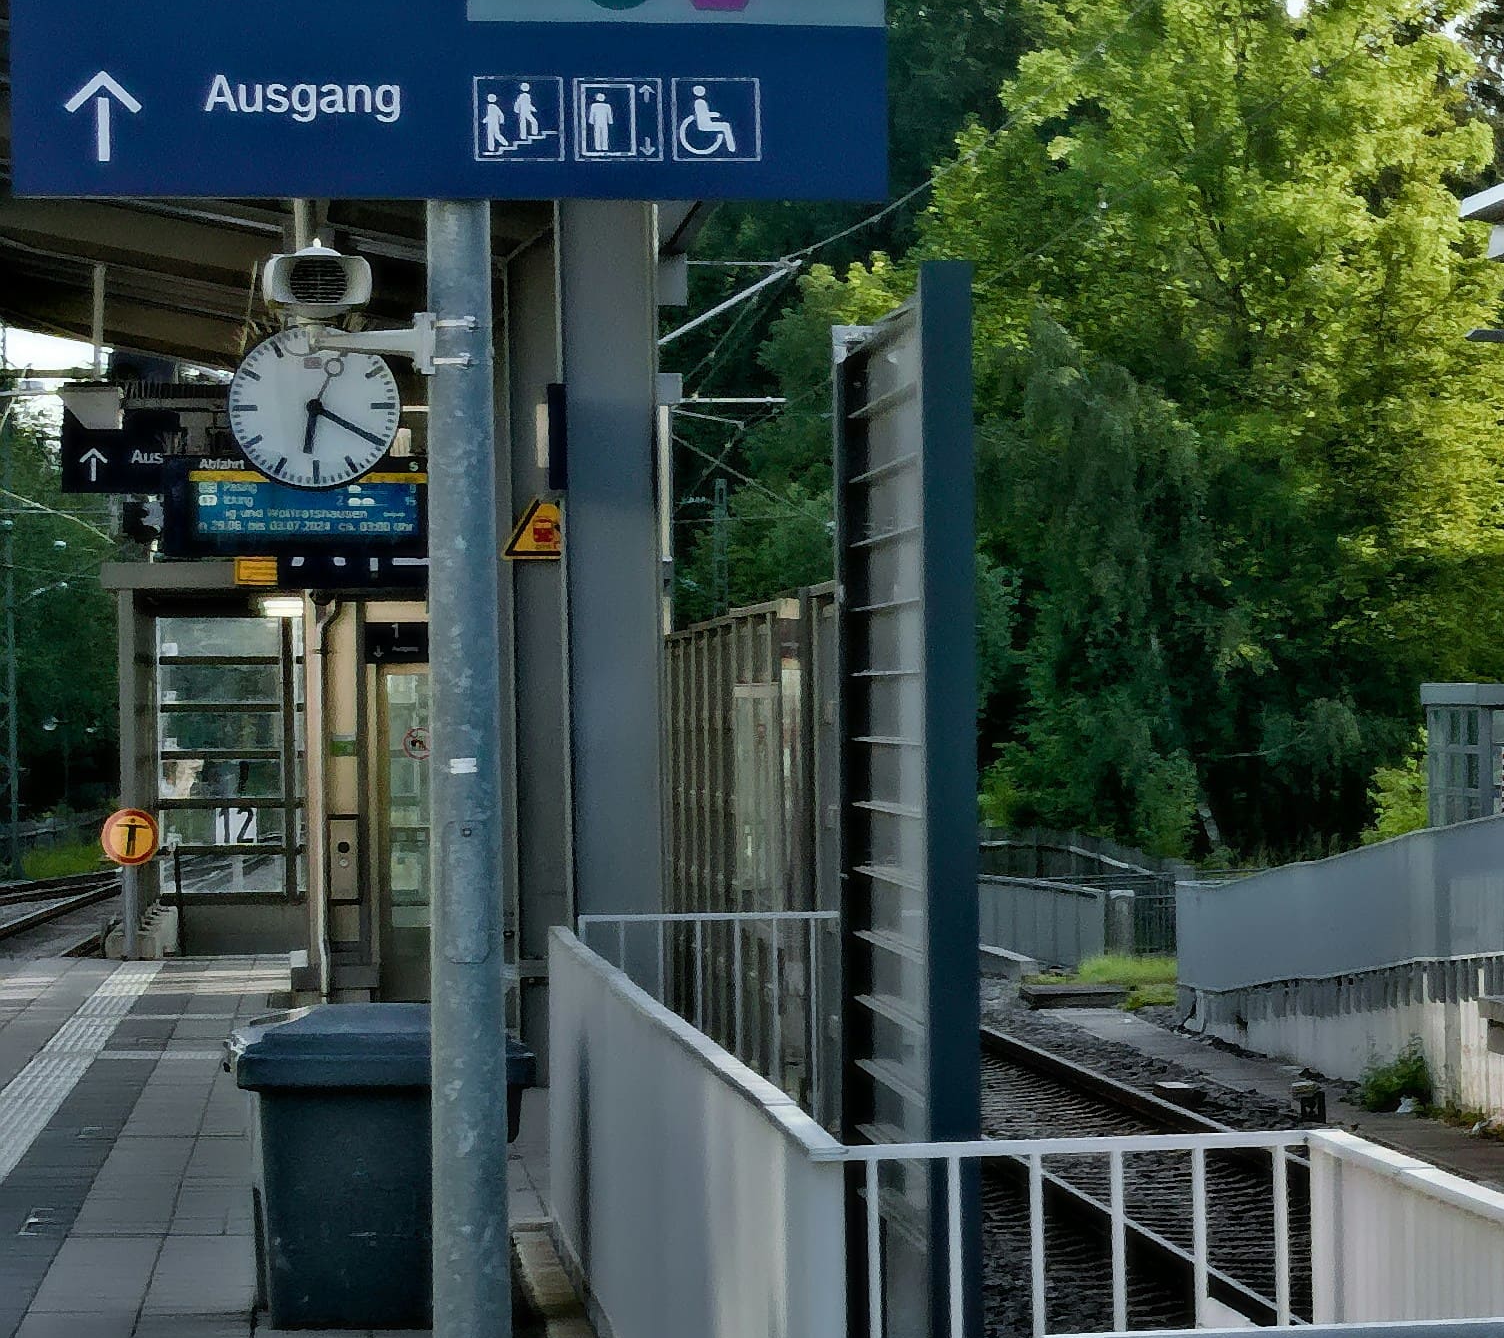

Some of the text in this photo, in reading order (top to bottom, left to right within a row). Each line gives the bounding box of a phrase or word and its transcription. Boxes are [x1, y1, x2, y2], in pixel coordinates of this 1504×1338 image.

[204, 74, 401, 123] Ausgang
[131, 449, 164, 464] Aus
[199, 458, 246, 470] Abfahrt
[219, 808, 254, 843] 12
